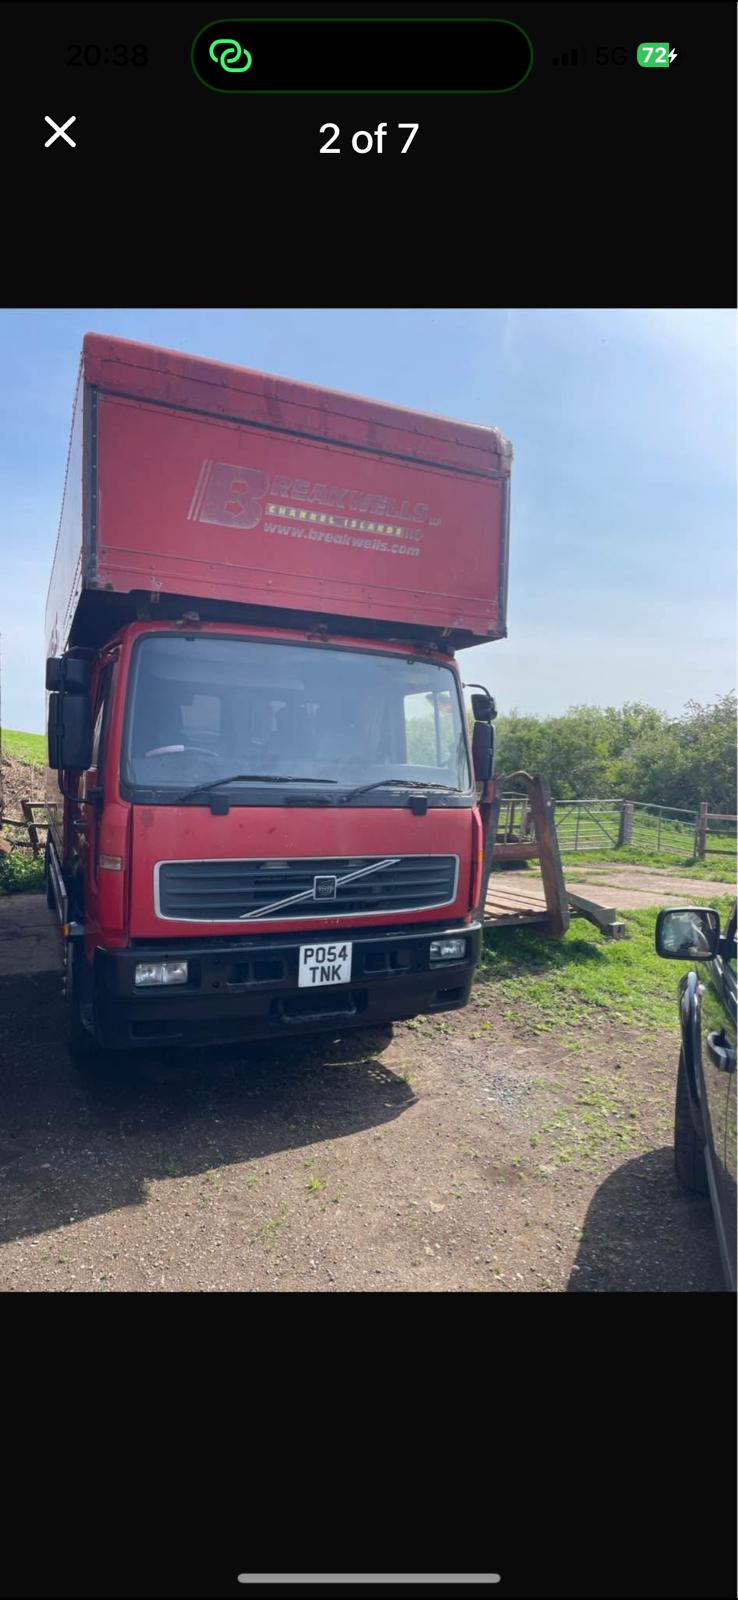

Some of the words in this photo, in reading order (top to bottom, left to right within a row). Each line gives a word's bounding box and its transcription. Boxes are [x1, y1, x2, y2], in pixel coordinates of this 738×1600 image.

[268, 503, 336, 525] CHANNEL
[344, 517, 402, 536] ISLANDS
[263, 522, 421, 557] www.breakwells.com
[303, 944, 348, 965] PO54
[309, 964, 342, 983] TNK
